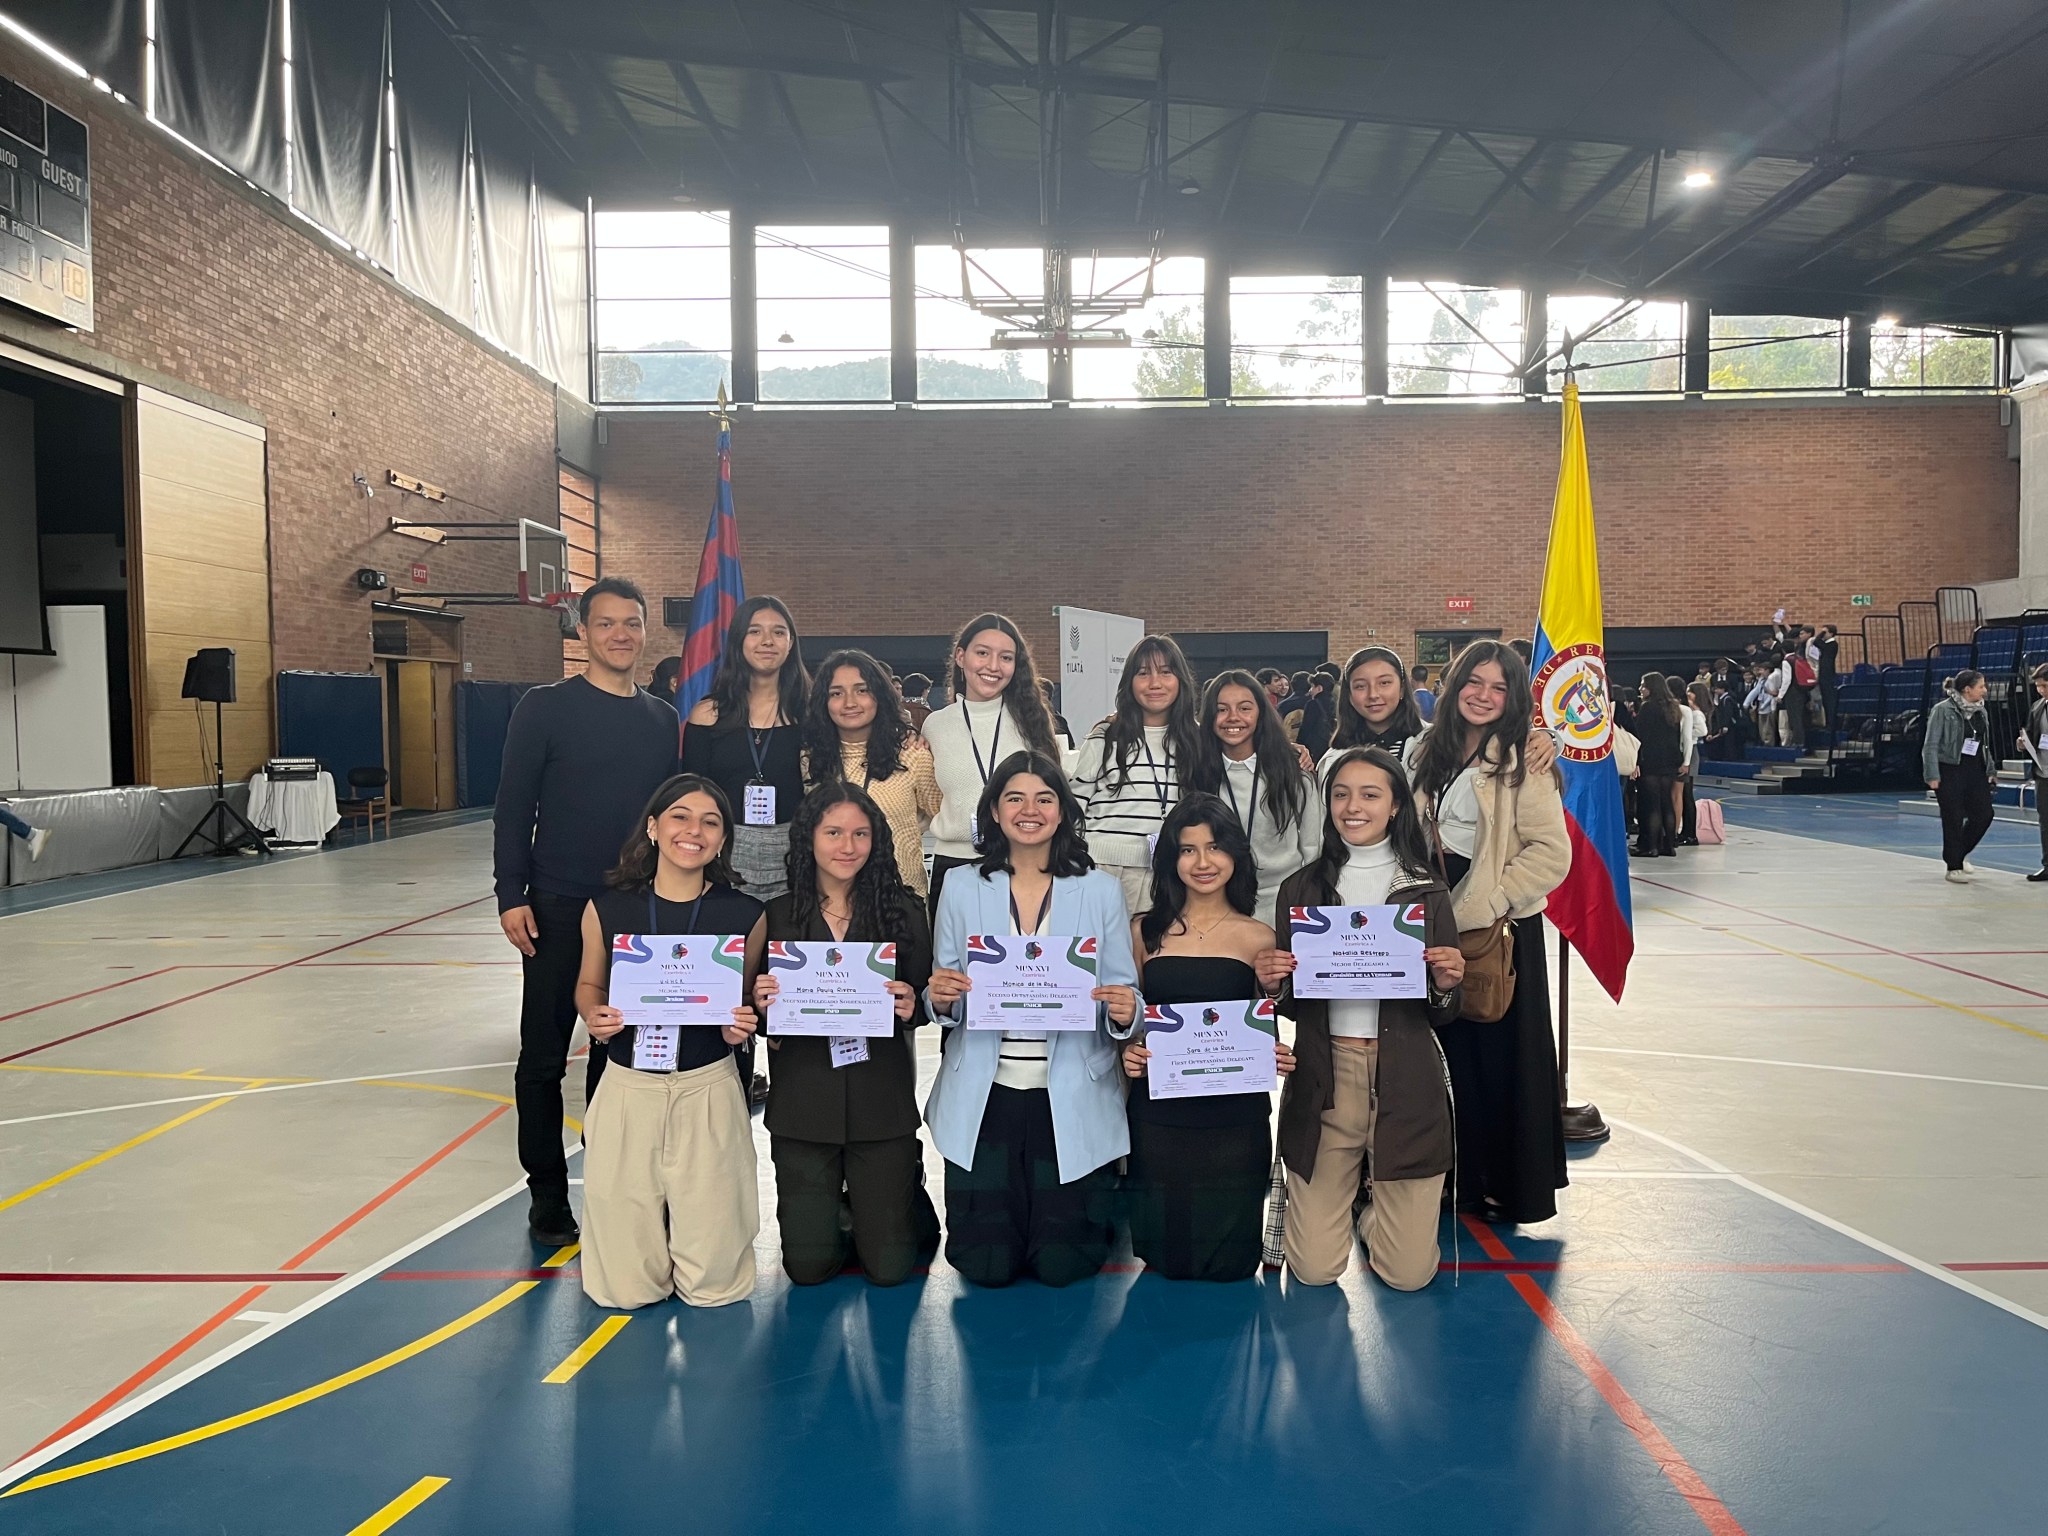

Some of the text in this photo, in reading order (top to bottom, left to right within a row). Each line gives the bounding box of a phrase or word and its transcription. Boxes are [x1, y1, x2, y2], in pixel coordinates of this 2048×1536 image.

[42, 159, 81, 195] GUEST
[12, 220, 34, 243] FOUL
[413, 567, 427, 579] EXIT
[1448, 600, 1471, 608] EXIT
[1534, 663, 1555, 688] DE
[1193, 1031, 1212, 1039] MUN
